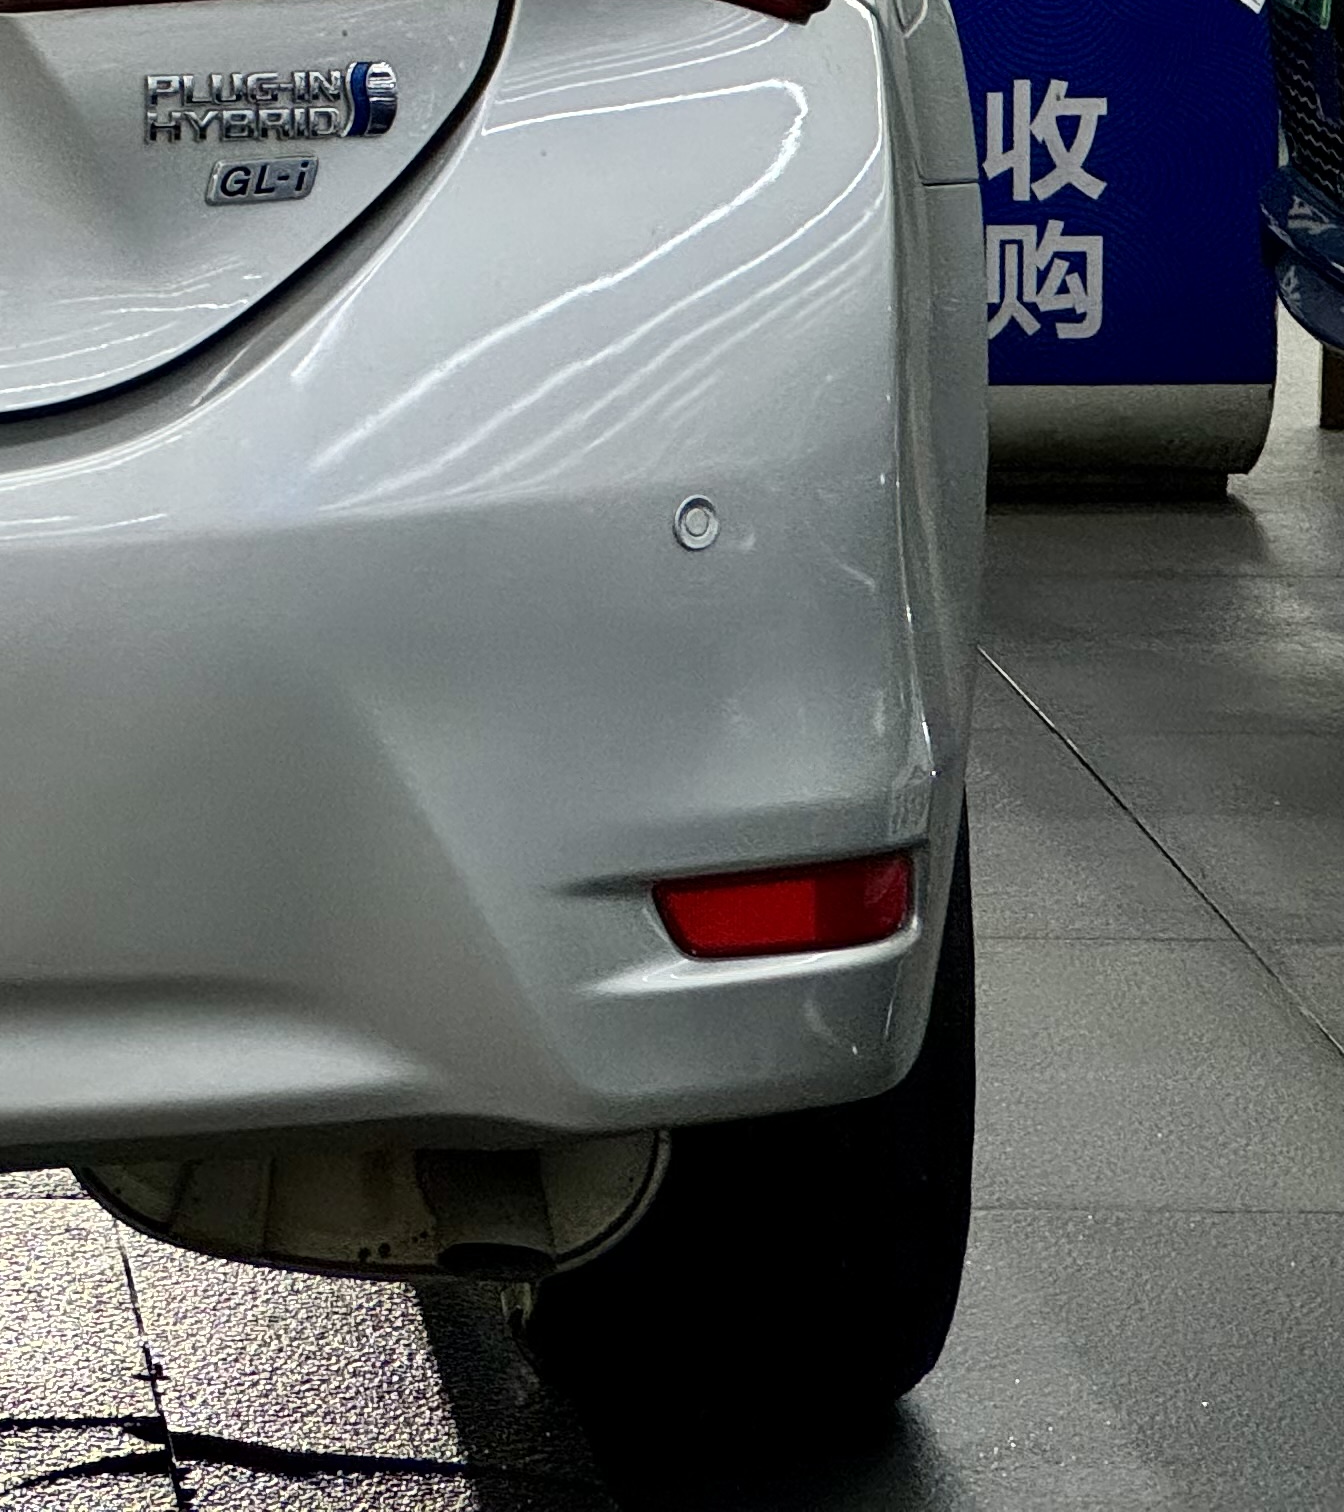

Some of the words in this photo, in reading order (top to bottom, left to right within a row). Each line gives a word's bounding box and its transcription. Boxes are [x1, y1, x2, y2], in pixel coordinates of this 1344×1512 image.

[145, 69, 342, 106] PLUG-IN
[144, 106, 341, 143] HYBRID
[220, 161, 310, 197] GL-i
[982, 77, 1109, 341] 收购
